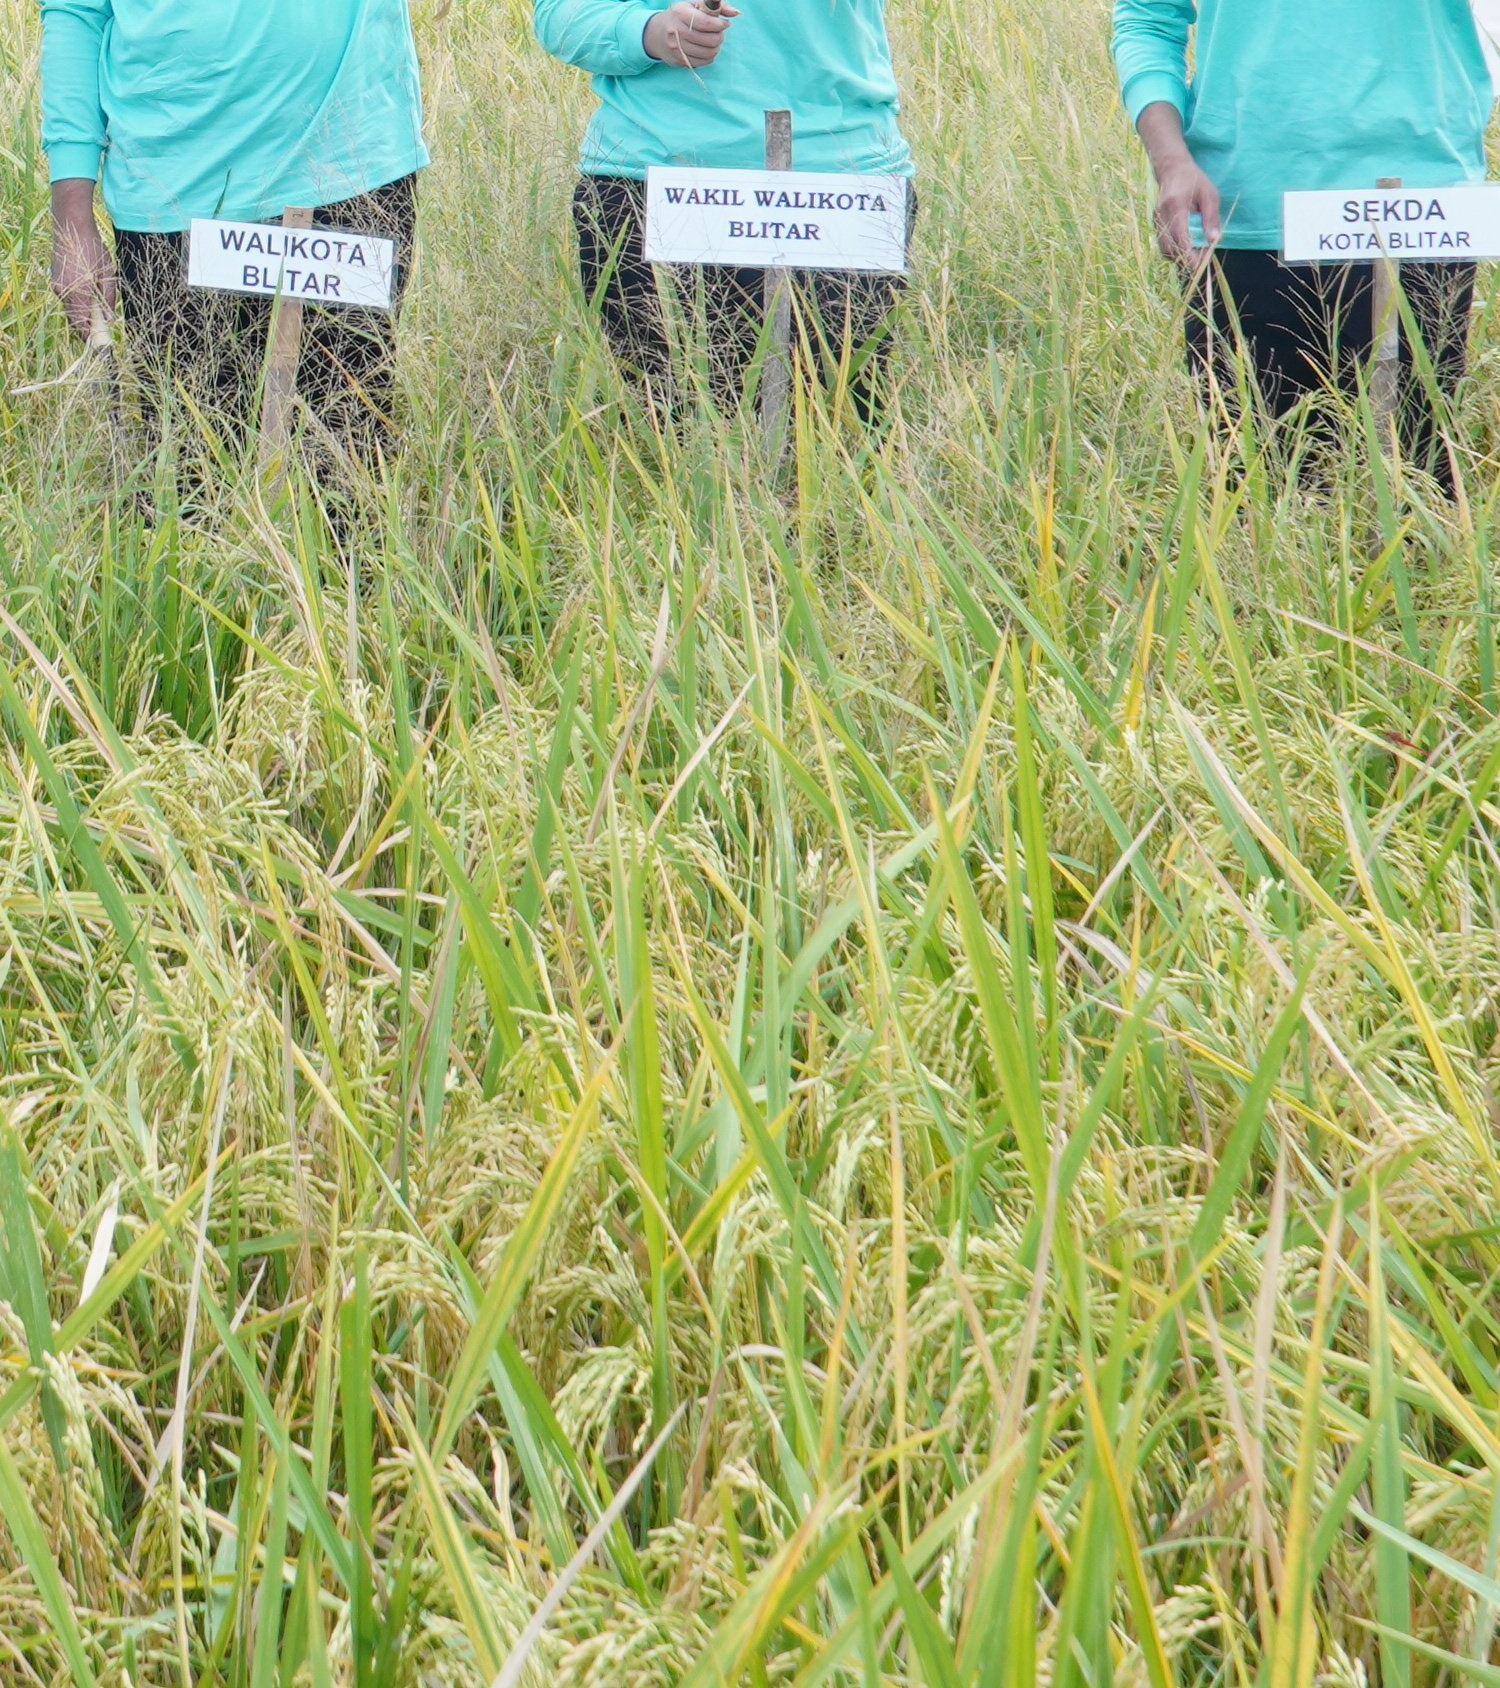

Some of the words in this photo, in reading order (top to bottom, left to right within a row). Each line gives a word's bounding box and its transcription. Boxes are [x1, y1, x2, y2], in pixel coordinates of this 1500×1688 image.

[664, 187, 744, 206] WAKIL
[754, 190, 887, 212] WALIKOTA
[1342, 199, 1446, 223] SEKDA
[728, 220, 821, 241] BLITAR
[1319, 233, 1382, 250] KOTA
[1389, 231, 1471, 249] BLITAR
[220, 228, 366, 267] WALIKOTA
